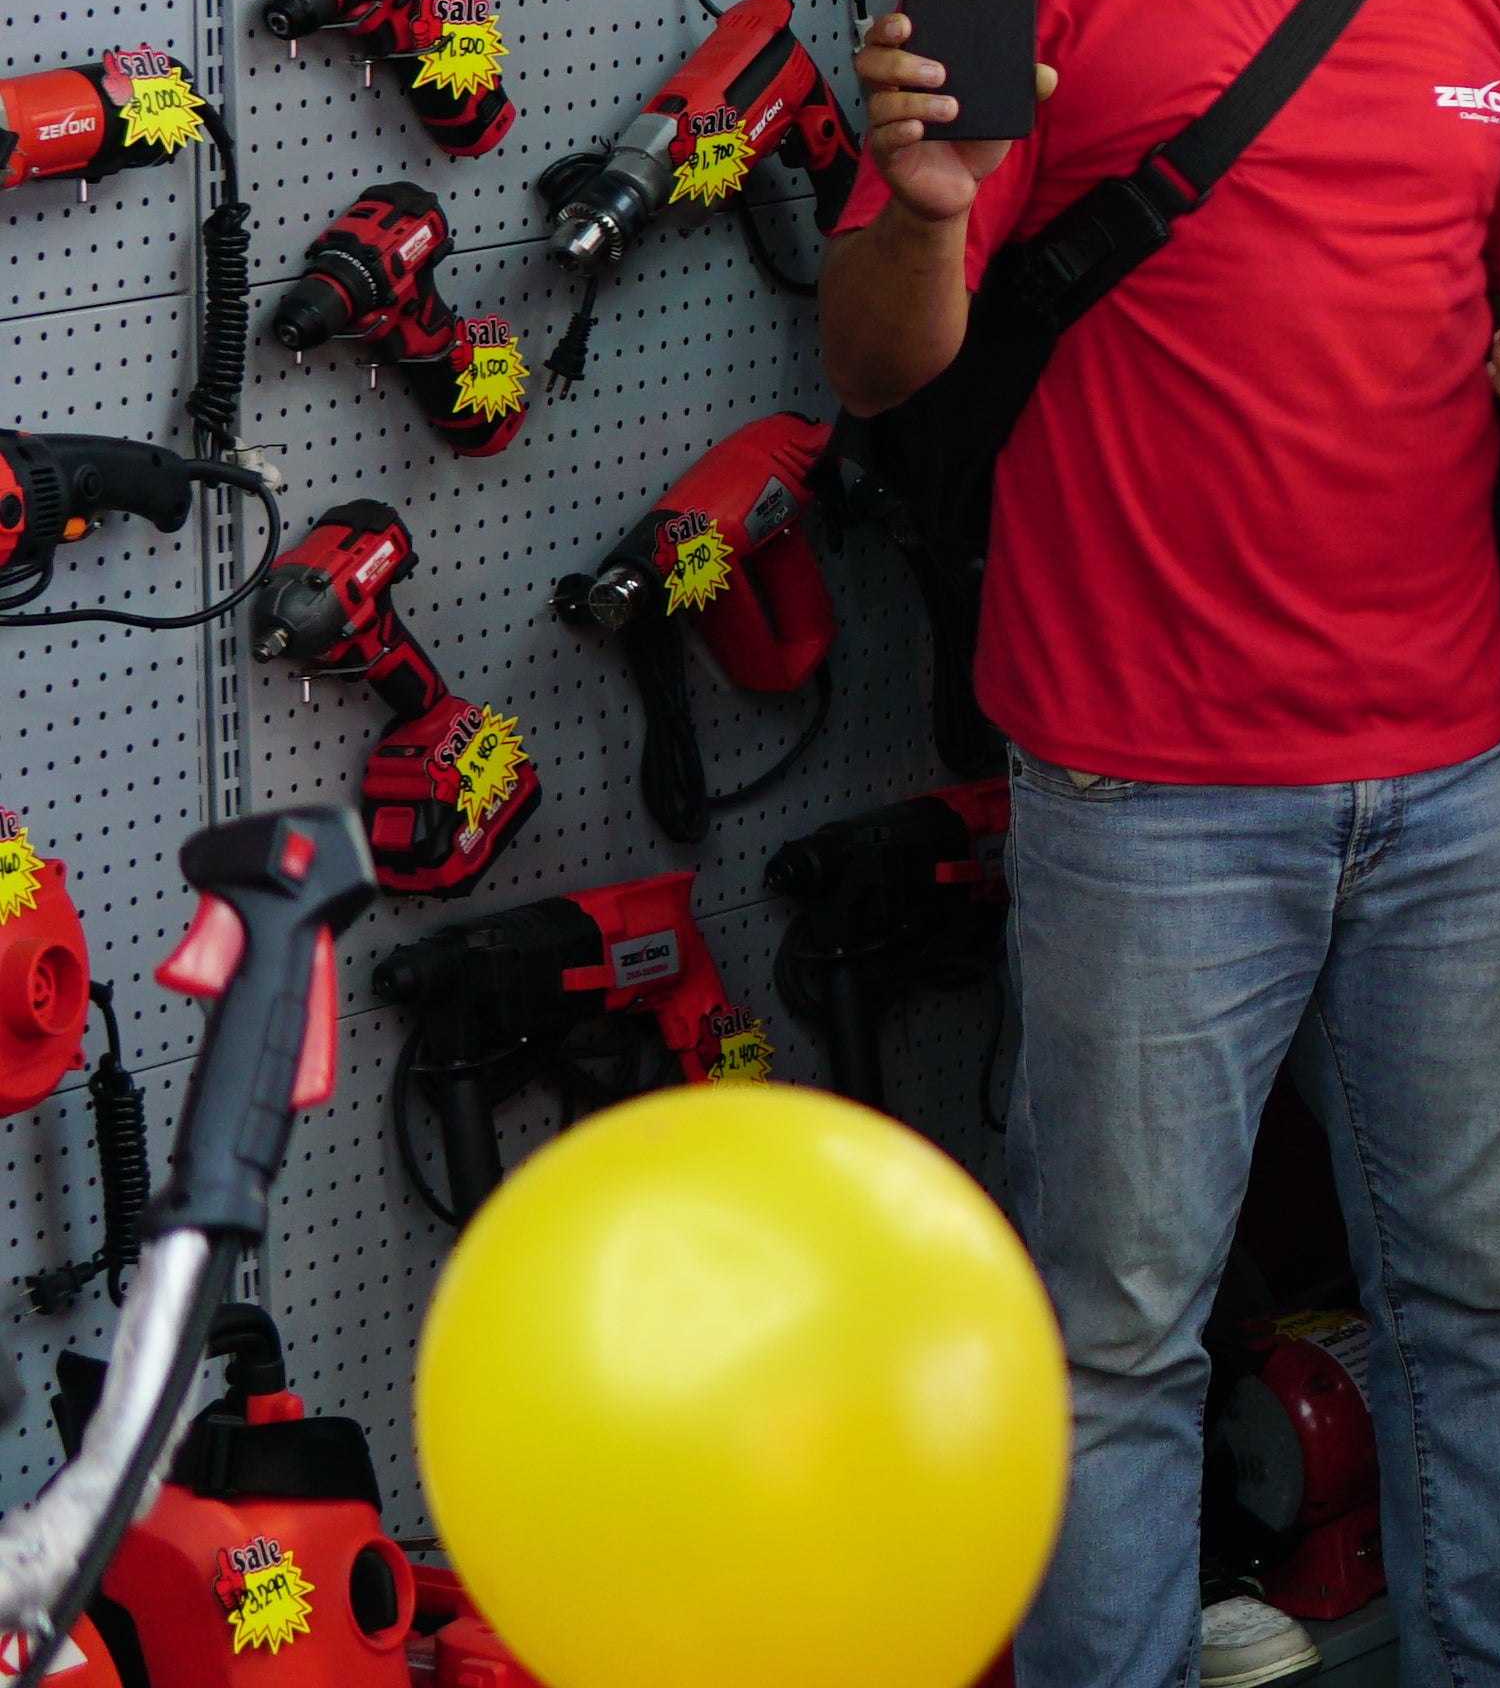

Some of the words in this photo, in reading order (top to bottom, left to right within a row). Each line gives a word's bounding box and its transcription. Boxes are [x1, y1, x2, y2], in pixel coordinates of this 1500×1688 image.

[118, 49, 171, 78] sale
[38, 111, 96, 141] ZEKOKI
[690, 106, 739, 136] sale
[748, 98, 784, 142] ZEKOKI
[465, 318, 510, 345] sale
[666, 509, 709, 545] sale
[437, 706, 483, 768] sale
[620, 941, 671, 968] ZEKOKI
[711, 1008, 753, 1038] sale
[233, 1539, 282, 1573] sale
